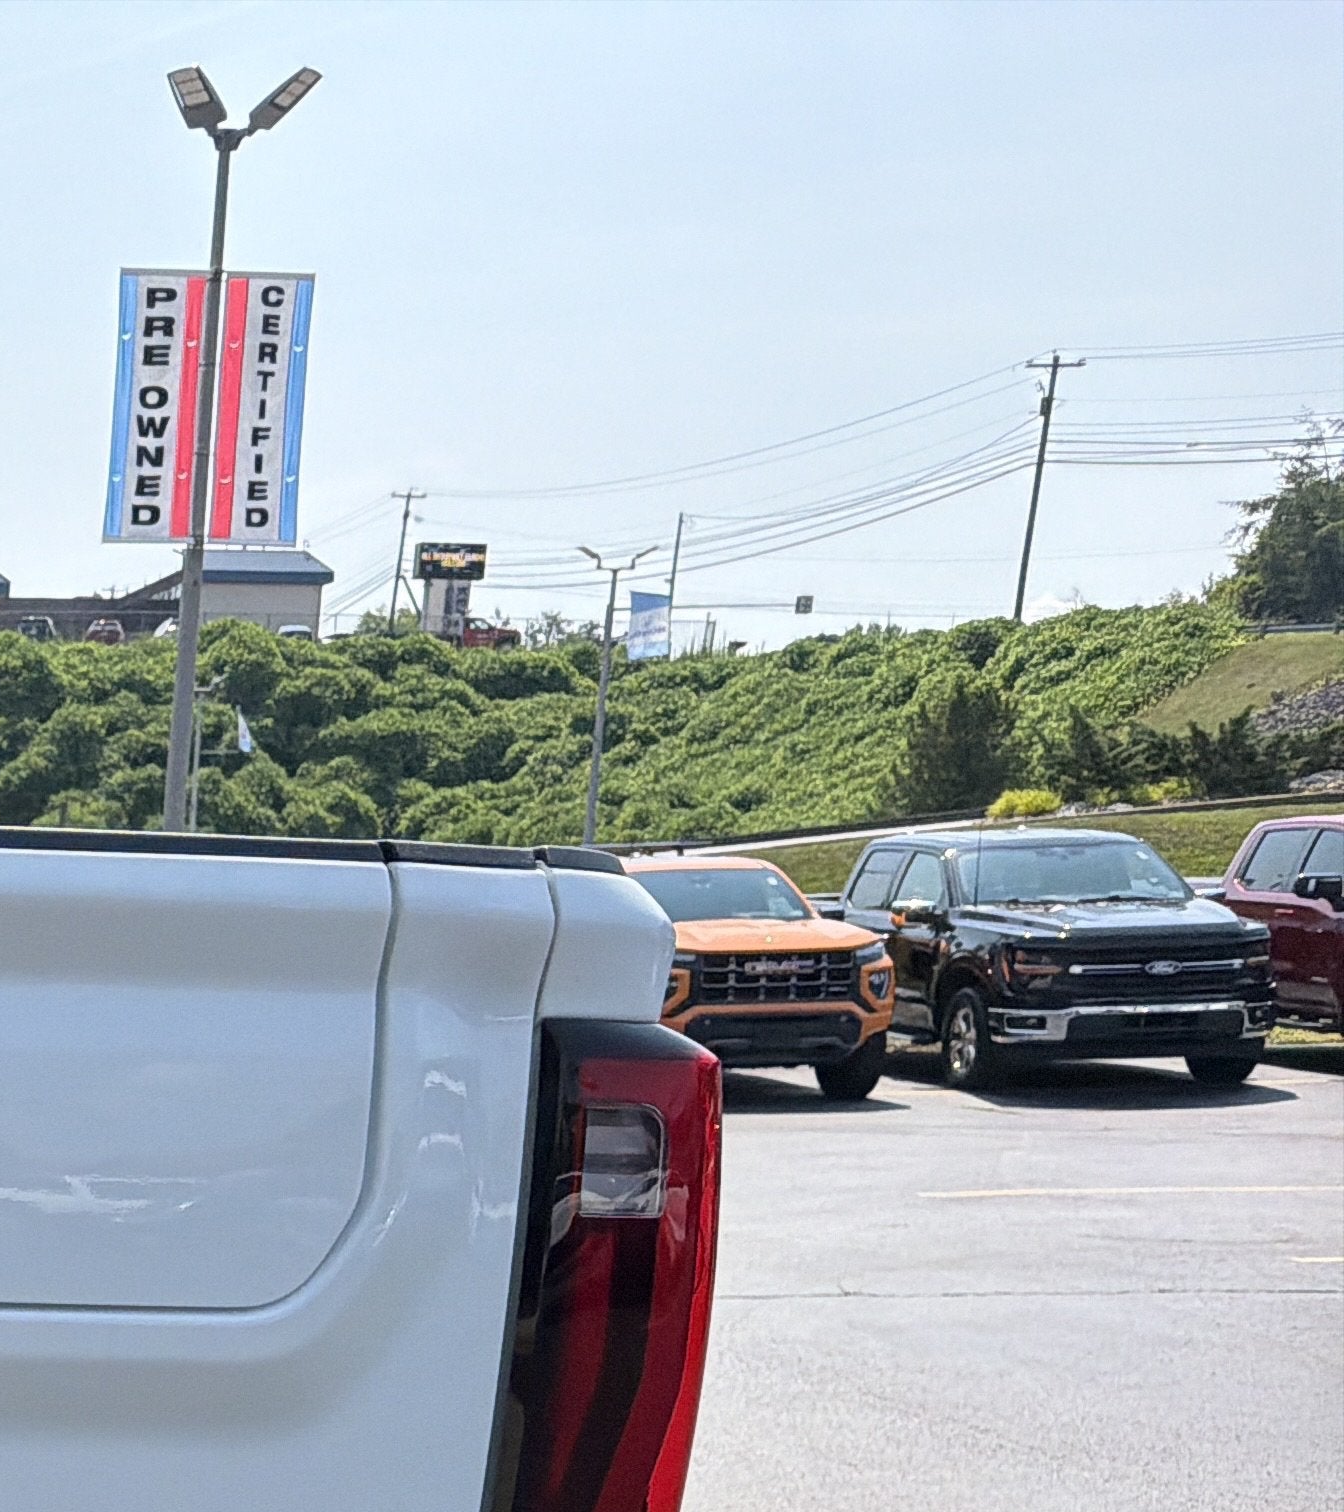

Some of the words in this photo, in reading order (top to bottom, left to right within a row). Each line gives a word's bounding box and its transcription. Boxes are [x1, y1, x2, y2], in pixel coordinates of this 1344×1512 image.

[143, 287, 177, 366] PRE
[131, 386, 169, 526] OWNED
[245, 286, 285, 528] CERTIFIED
